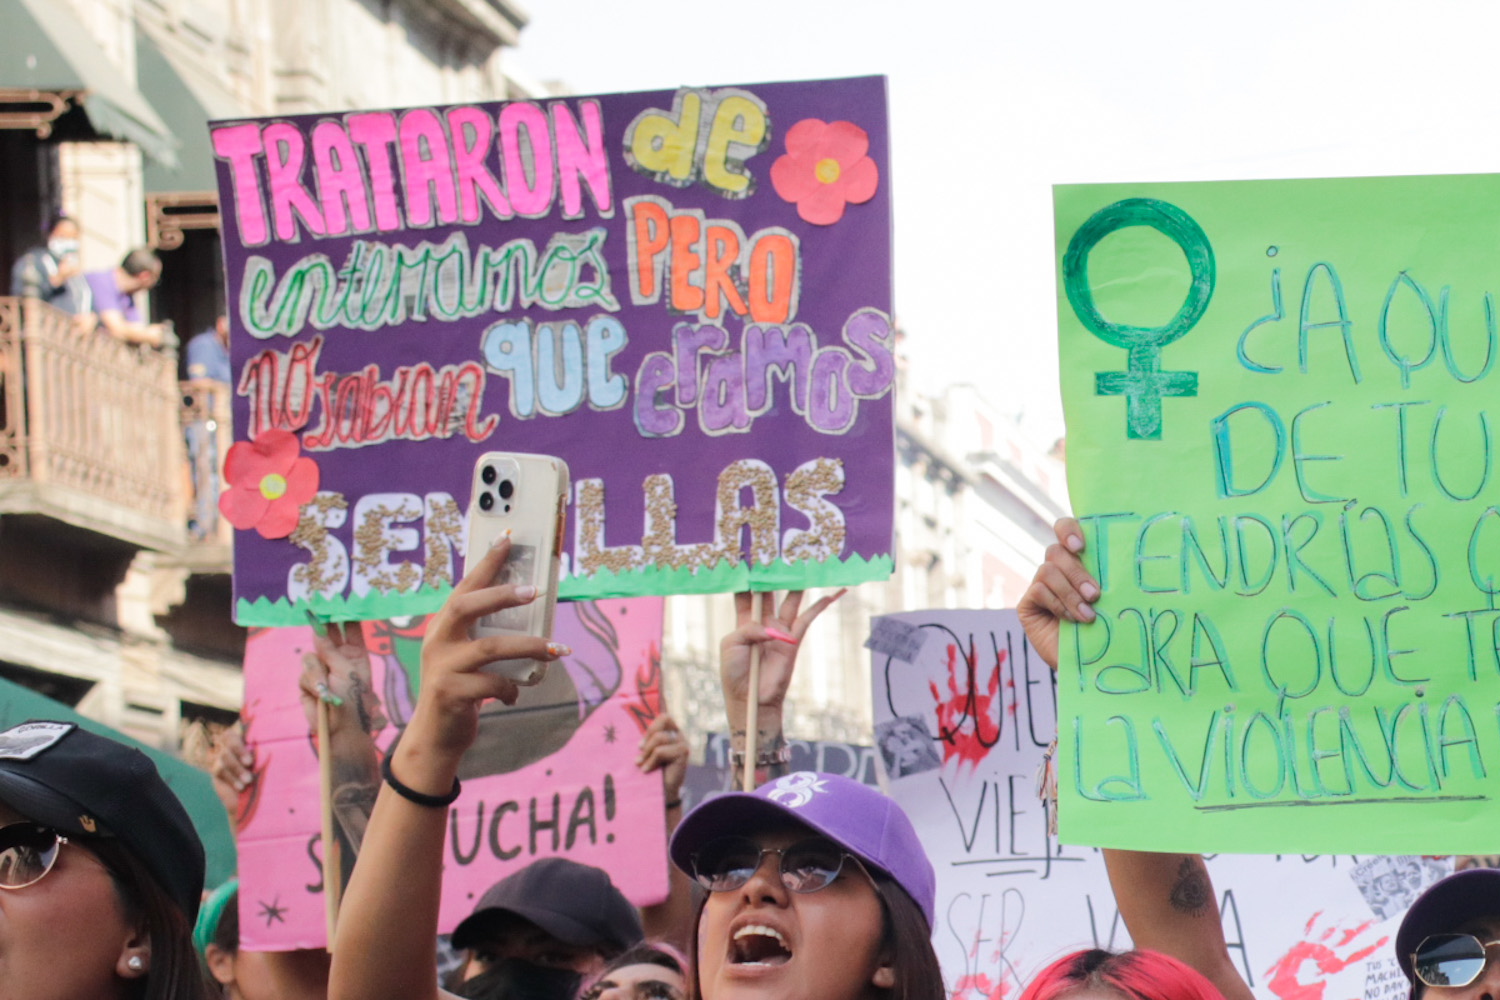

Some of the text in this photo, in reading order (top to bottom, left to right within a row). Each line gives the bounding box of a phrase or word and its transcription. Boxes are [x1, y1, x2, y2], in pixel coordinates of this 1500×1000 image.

[211, 92, 768, 247] TRATARON de
[633, 200, 796, 325] PERO
[483, 315, 628, 417] que
[635, 308, 896, 437] eramos
[1210, 400, 1348, 504] DE
[1371, 400, 1492, 503] TU
[287, 455, 847, 602] SEMLLAS
[887, 623, 1058, 752] QUIE
[1260, 606, 1432, 710] QUE
[1364, 986, 1380, 1000] NO
